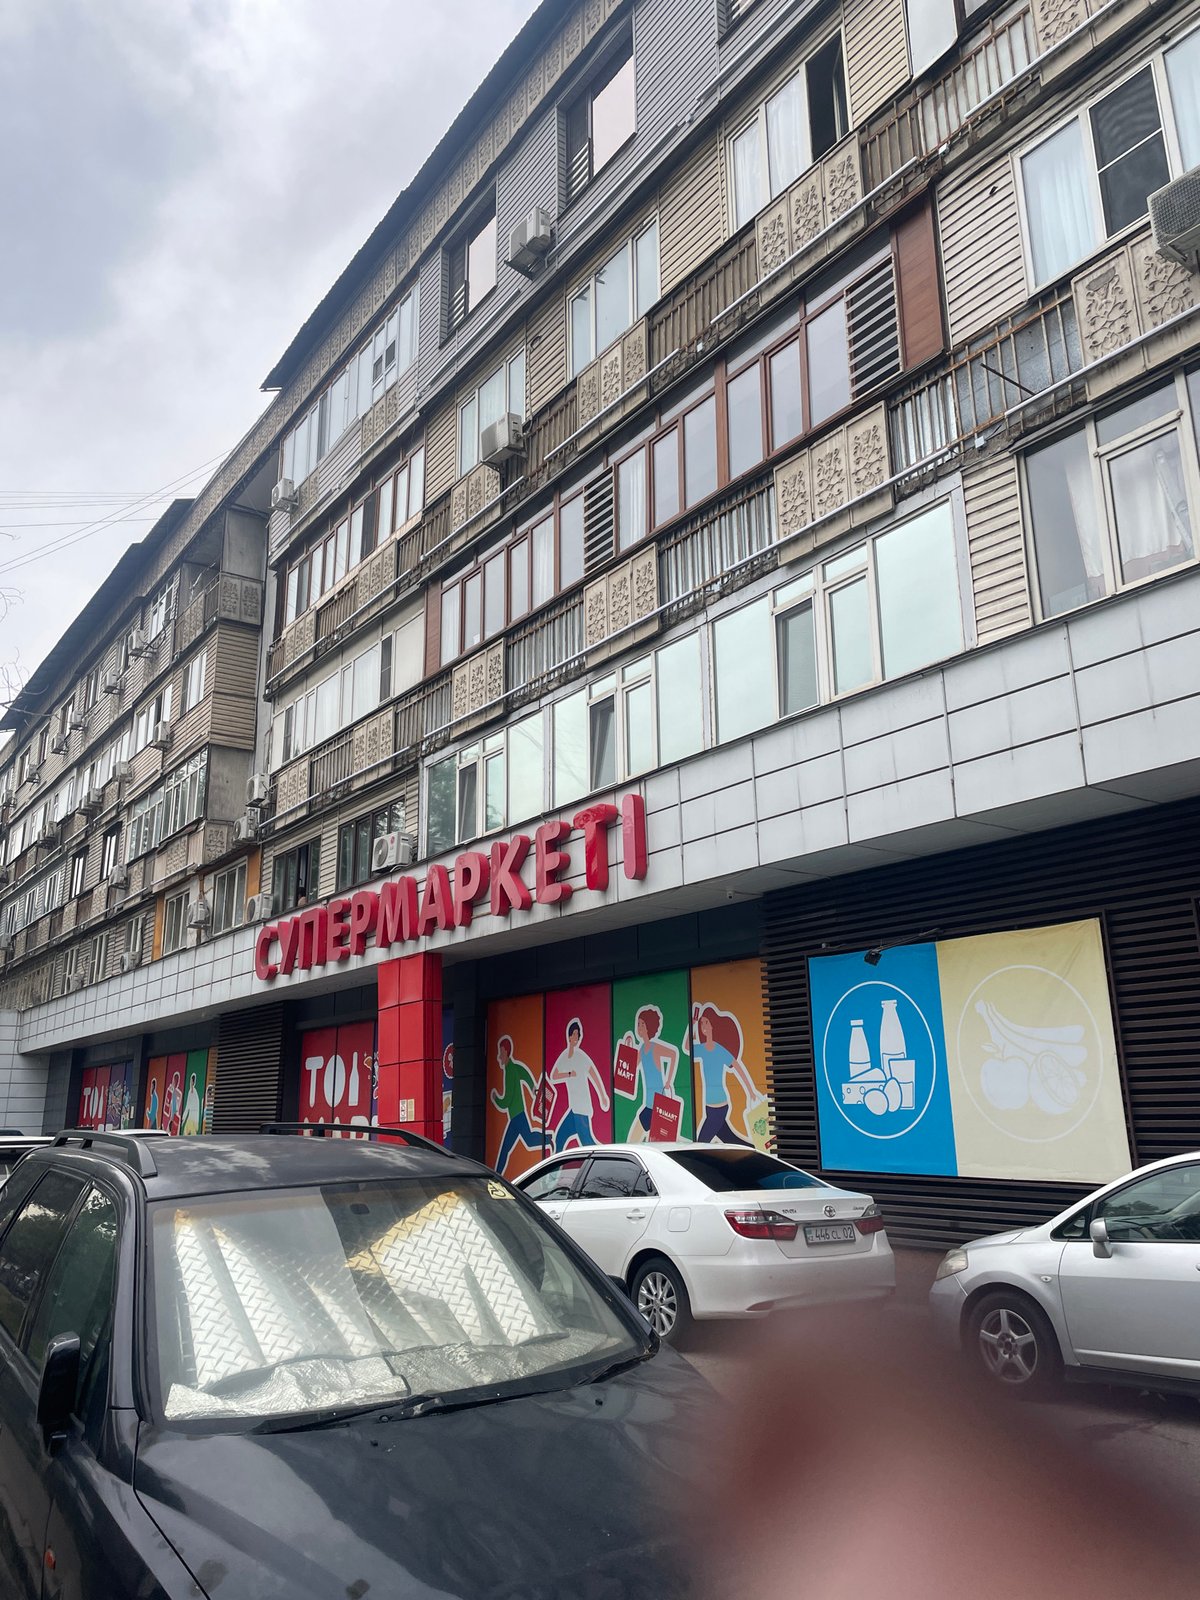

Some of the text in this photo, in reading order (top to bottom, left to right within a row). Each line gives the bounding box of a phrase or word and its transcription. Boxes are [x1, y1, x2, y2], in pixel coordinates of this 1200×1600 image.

[255, 793, 649, 981] СУПЕРМАРКЕТІ
[617, 1068, 634, 1081] MART
[815, 1228, 830, 1240] 446
[831, 1230, 841, 1239] CL
[843, 1227, 853, 1238] 02
